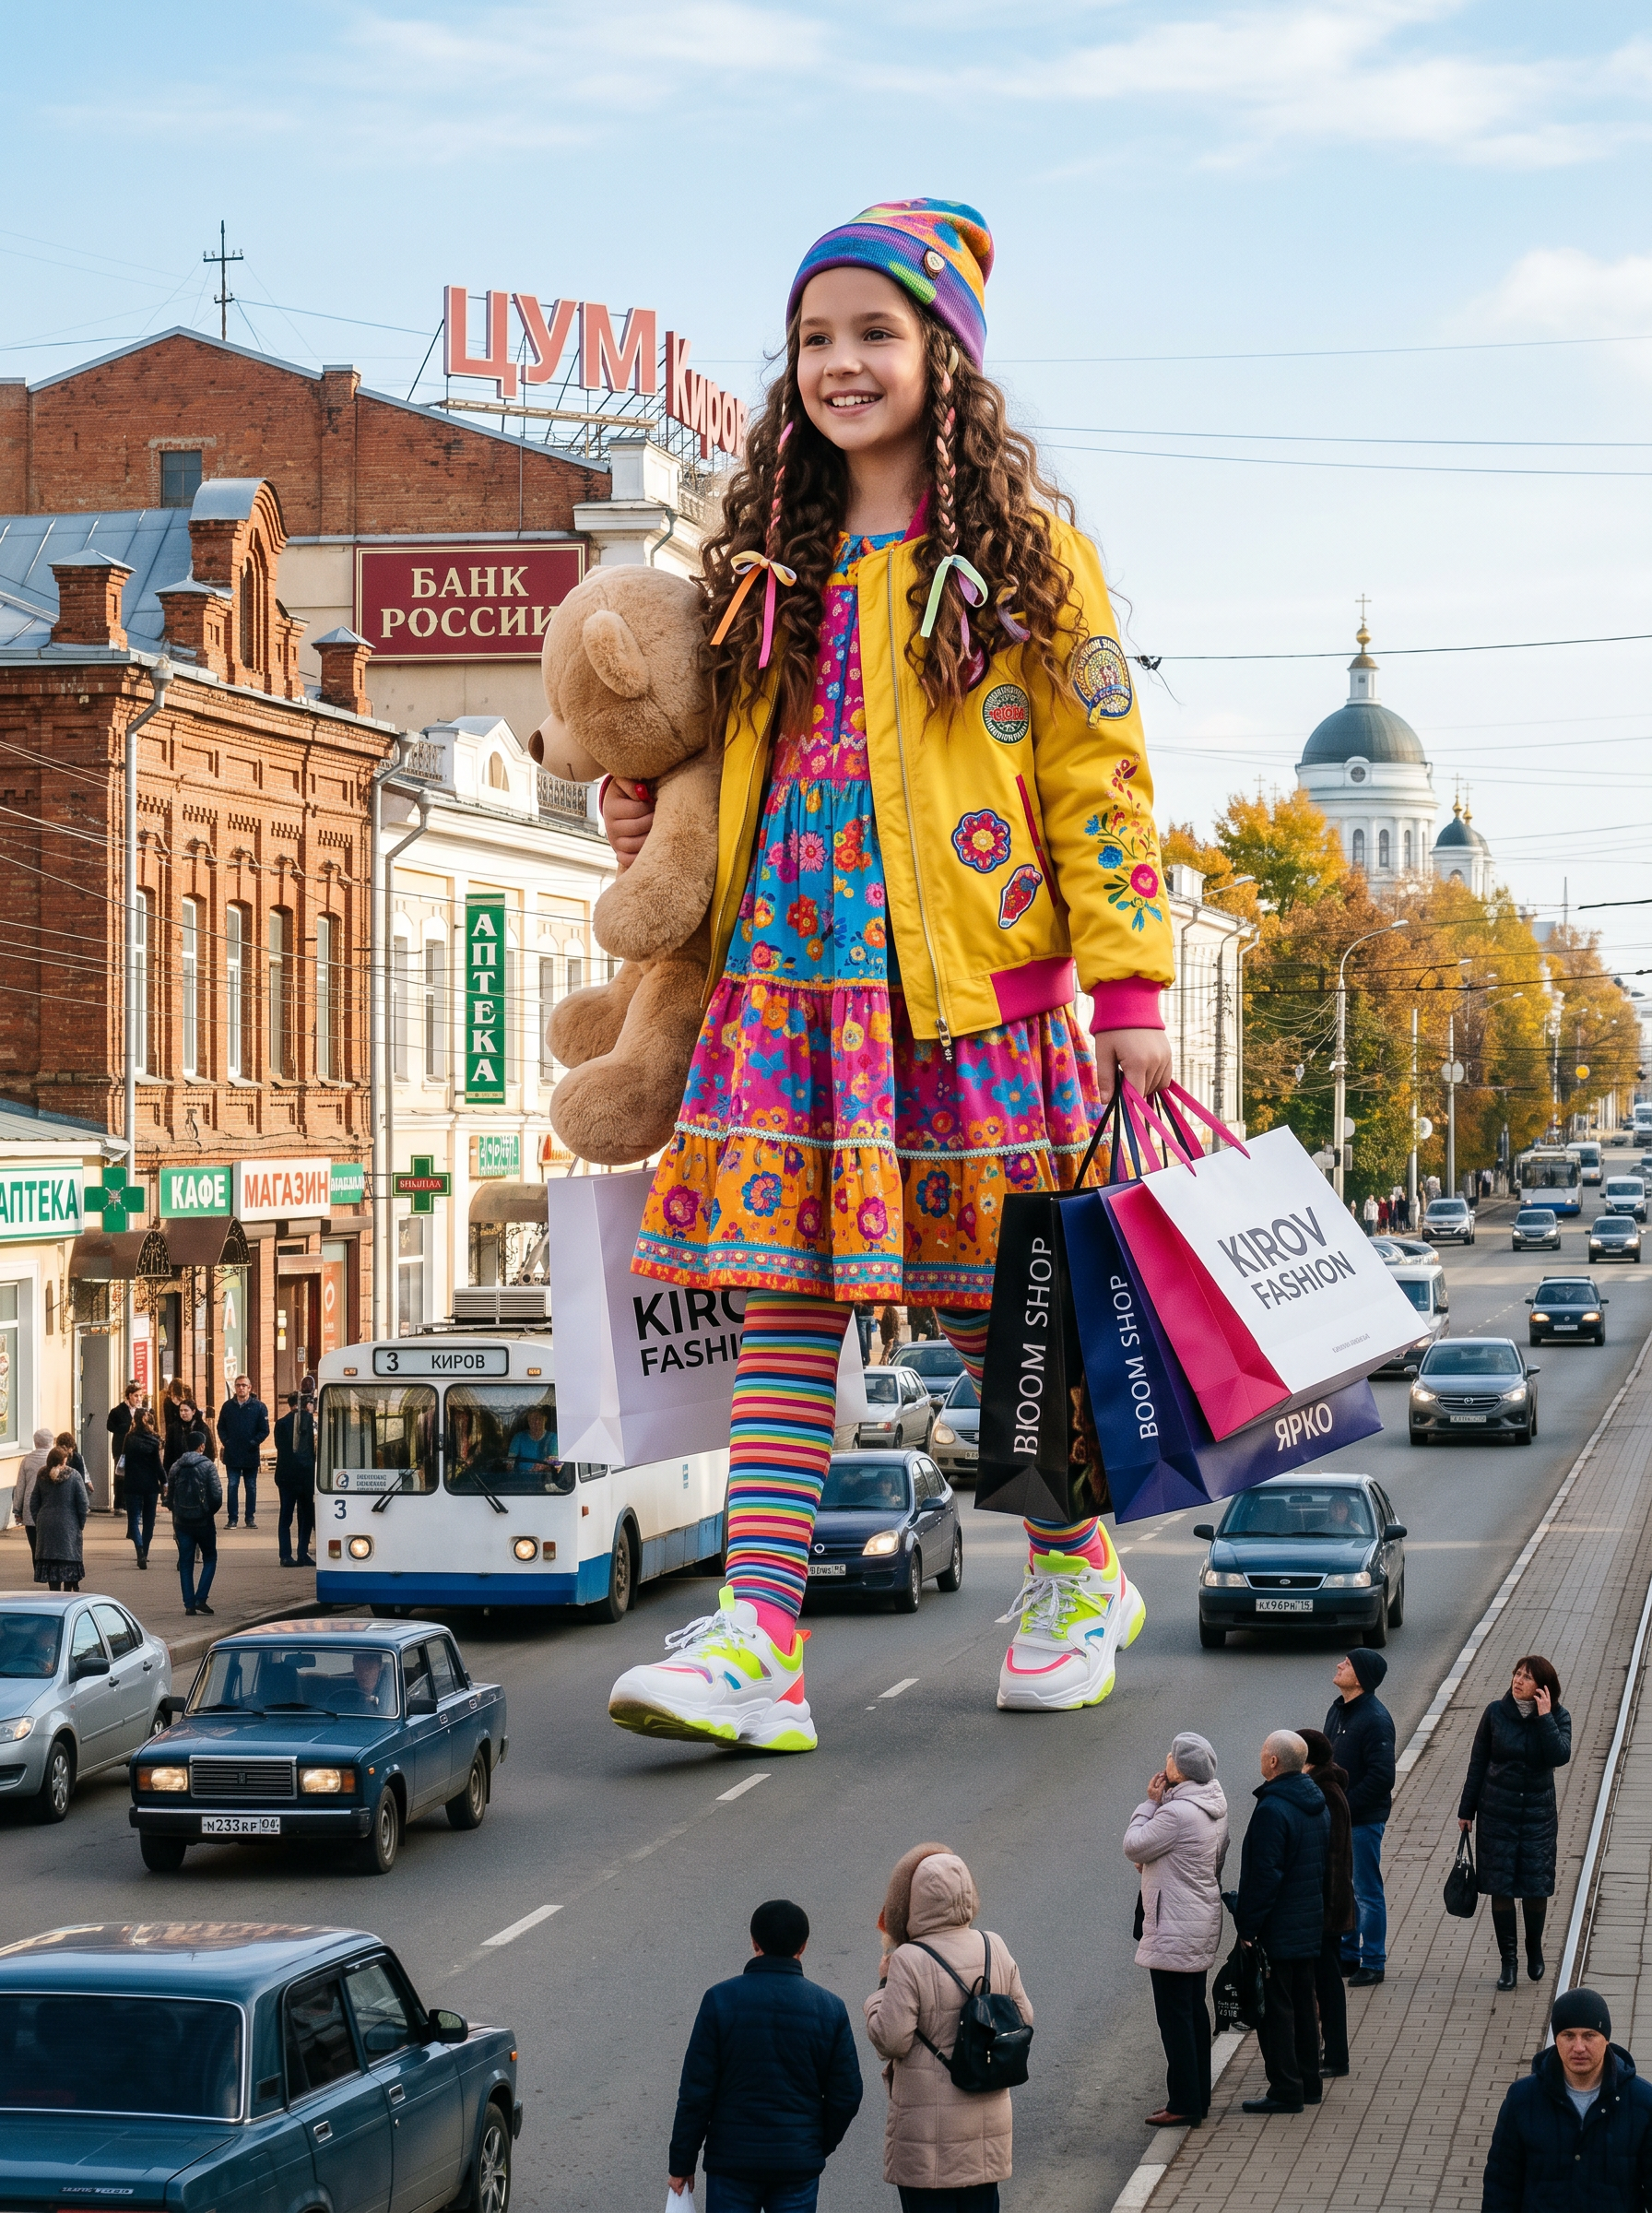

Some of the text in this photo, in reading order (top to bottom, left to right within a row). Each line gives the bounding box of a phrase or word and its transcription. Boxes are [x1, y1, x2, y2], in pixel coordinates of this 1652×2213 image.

[443, 285, 657, 399] ЦУМ
[411, 566, 529, 598] БАНК
[471, 913, 498, 1083] АПТЕКА
[171, 1174, 226, 1210] КАФЕ
[244, 1170, 328, 1209] МАГАЗИН
[1217, 1206, 1328, 1278] KIROV
[1025, 1237, 1053, 1328] SHOP
[1250, 1250, 1356, 1310] FASHION
[386, 1352, 486, 1372] 3 КИРОВ
[1110, 1274, 1159, 1440] BOOM SHOP
[1274, 1402, 1333, 1451] ЯРКО
[334, 1499, 347, 1520] 3
